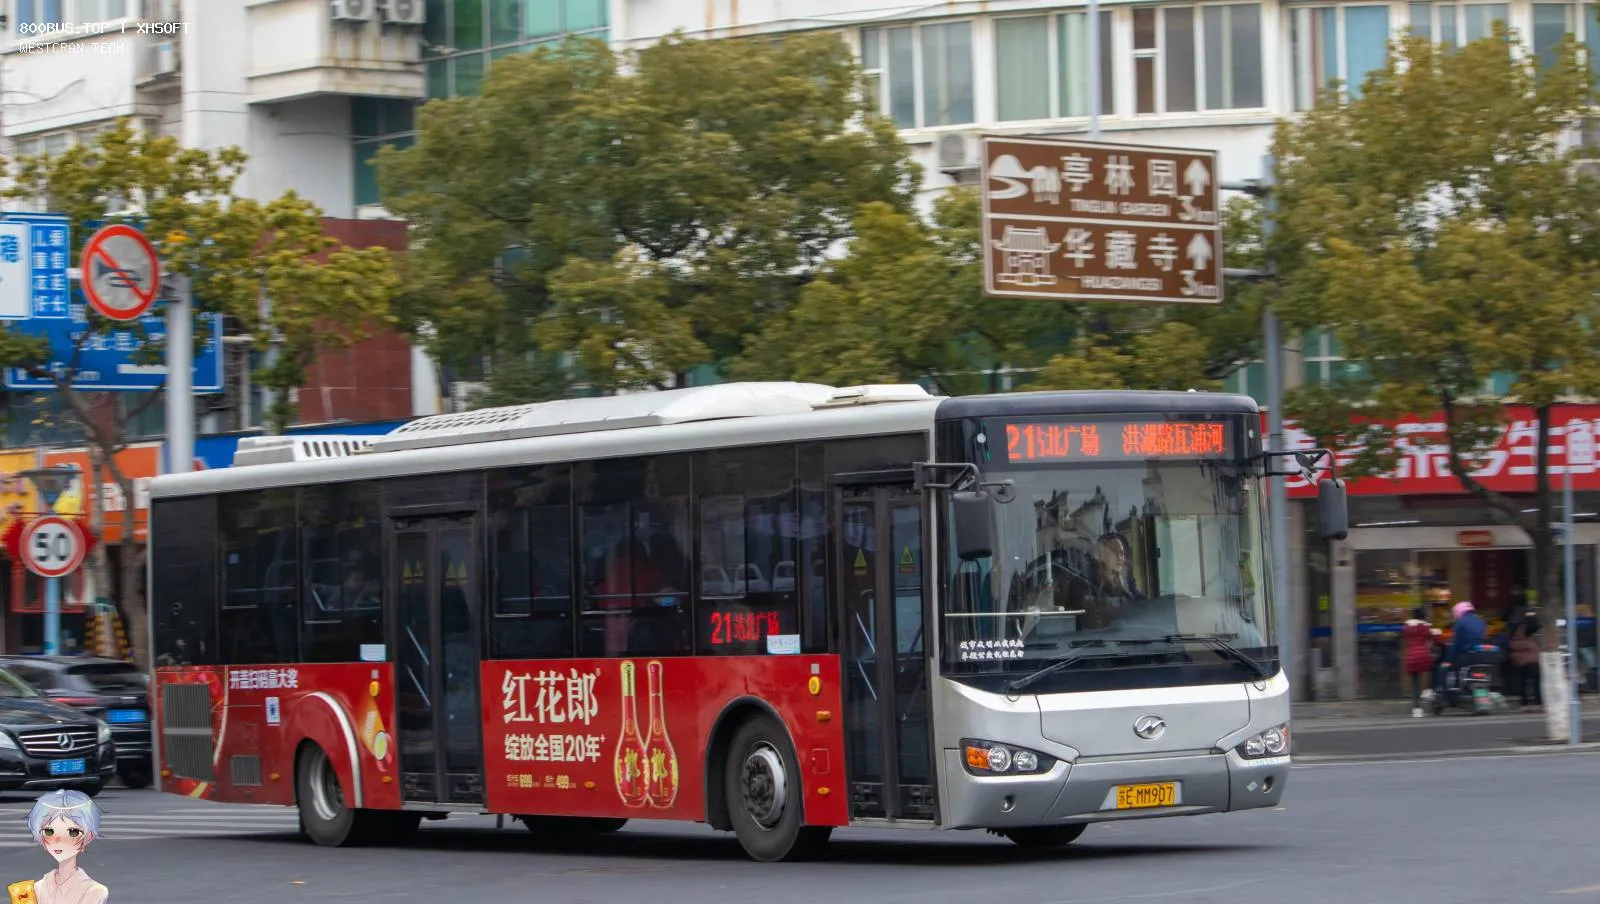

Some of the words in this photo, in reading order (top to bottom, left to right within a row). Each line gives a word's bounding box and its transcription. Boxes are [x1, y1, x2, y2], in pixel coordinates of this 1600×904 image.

[1060, 152, 1178, 198] 亭林园
[1062, 228, 1180, 272] 华藏寺
[1006, 423, 1036, 461] 21
[34, 532, 71, 562] 50
[711, 611, 732, 644] 21
[501, 668, 599, 725] 红花郎
